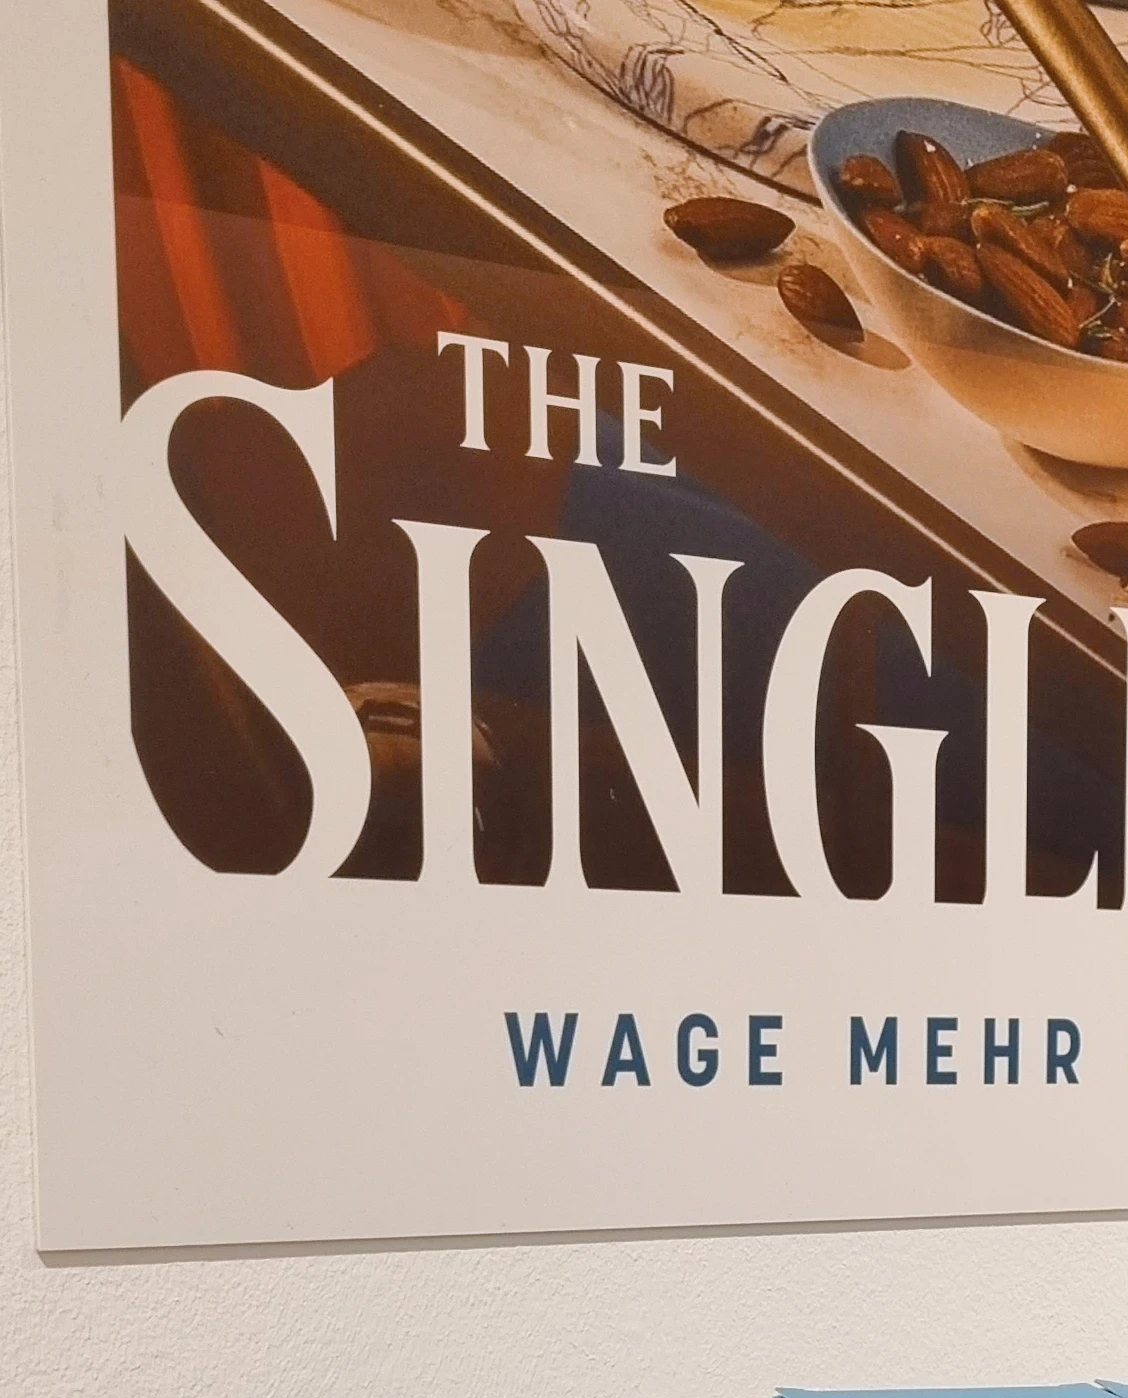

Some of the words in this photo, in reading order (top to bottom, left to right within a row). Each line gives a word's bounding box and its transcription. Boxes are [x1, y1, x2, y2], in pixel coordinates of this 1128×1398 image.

[437, 331, 679, 477] THE
[504, 1012, 784, 1087] WAGE
[849, 1016, 1082, 1085] MEHR
